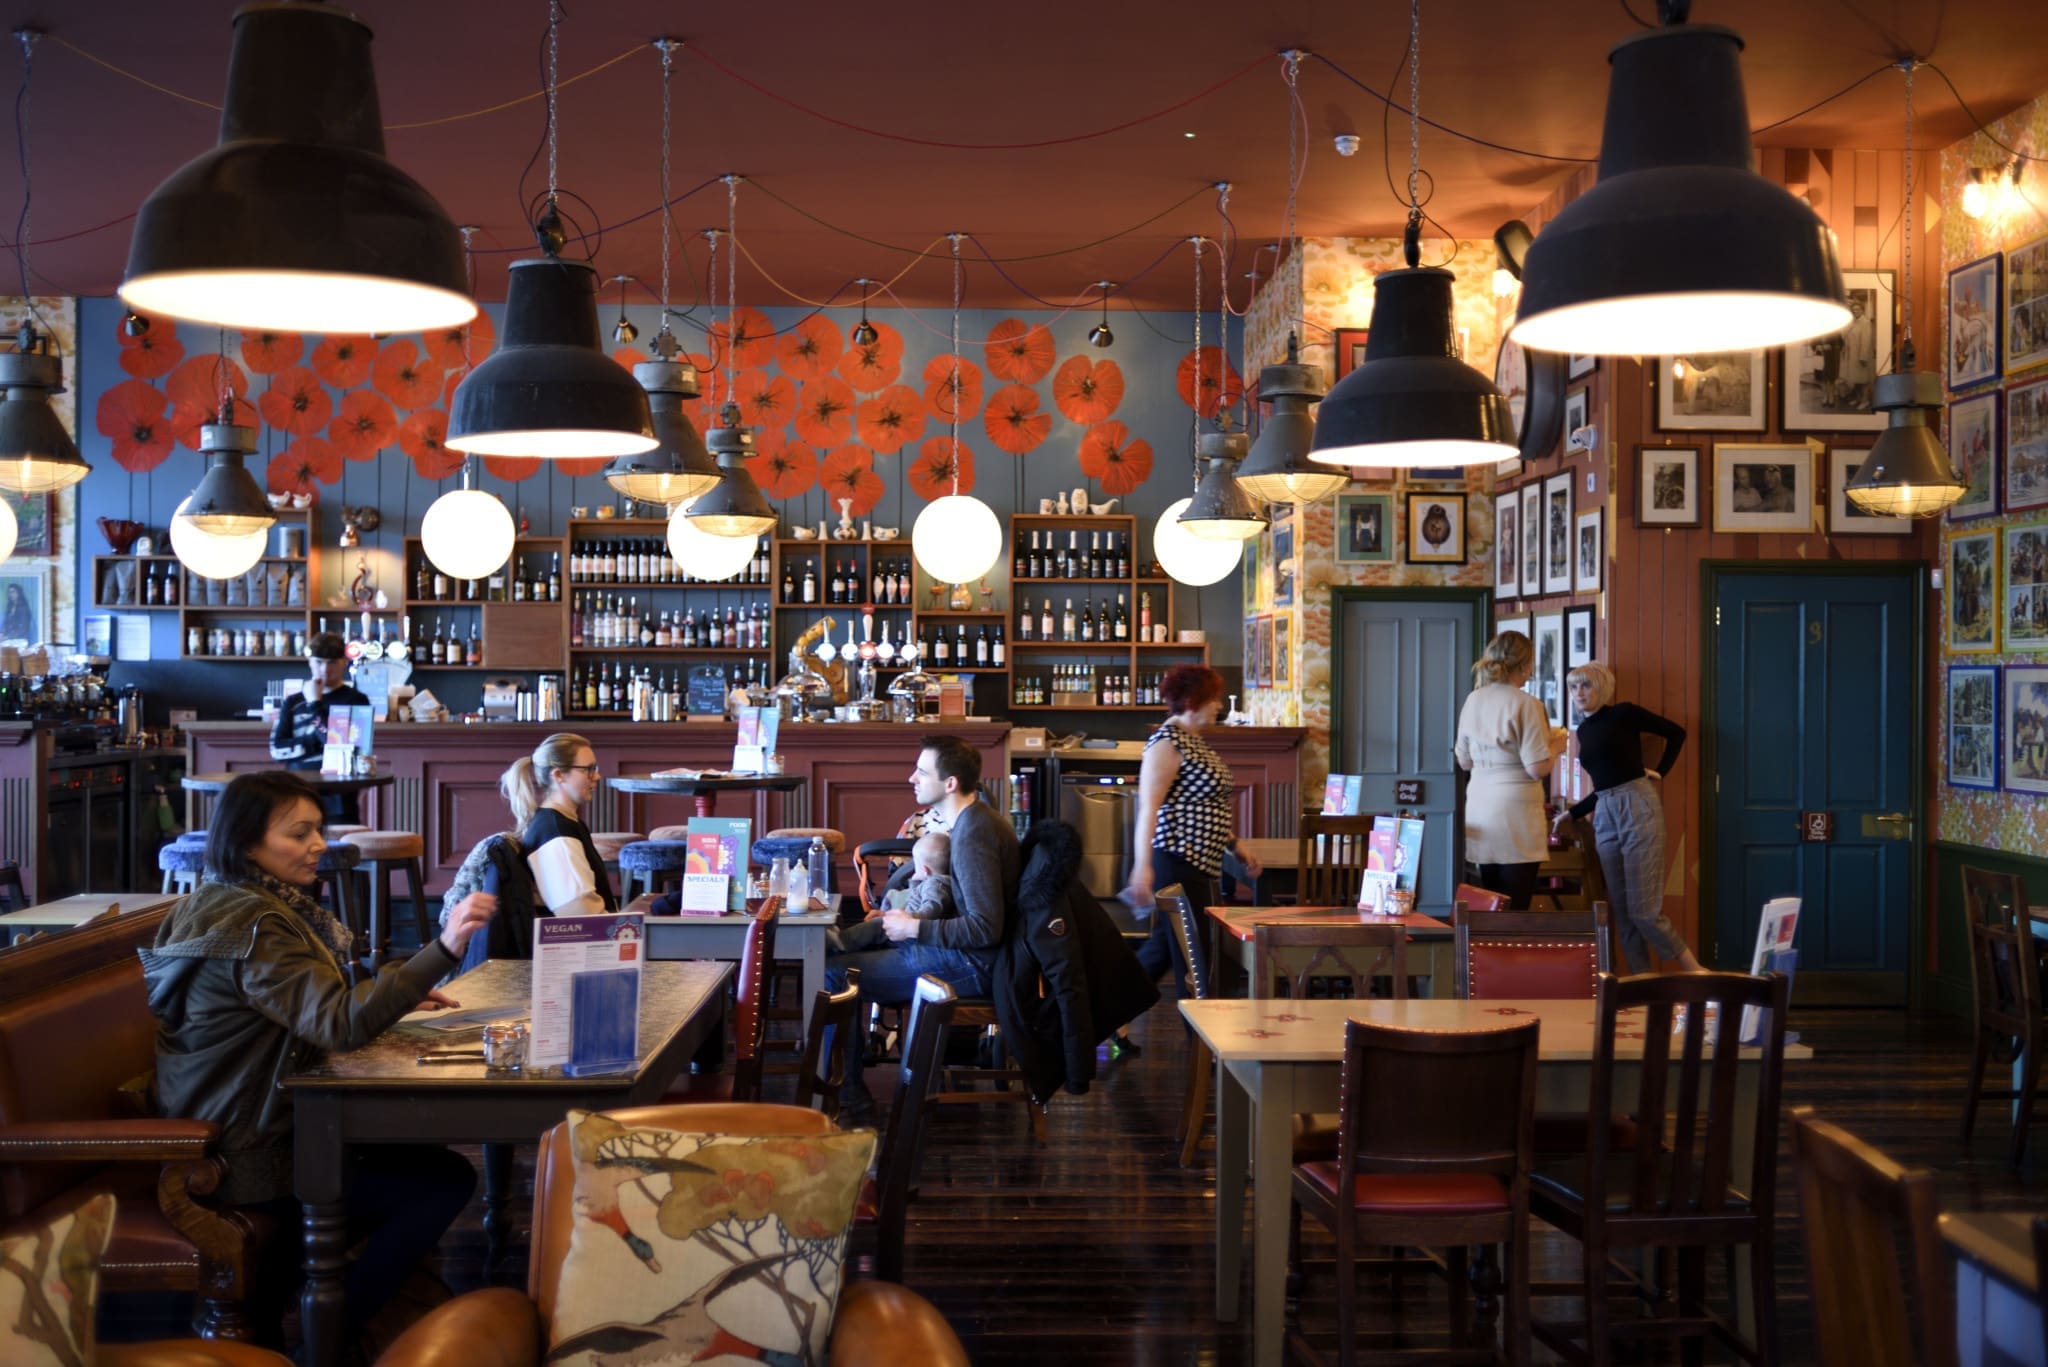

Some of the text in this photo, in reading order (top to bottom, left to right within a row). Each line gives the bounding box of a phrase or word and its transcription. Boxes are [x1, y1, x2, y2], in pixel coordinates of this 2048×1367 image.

[1399, 783, 1418, 792] Staff
[1399, 792, 1417, 802] Only
[687, 875, 725, 883] SPECIALS
[543, 923, 583, 934] VEGAN
